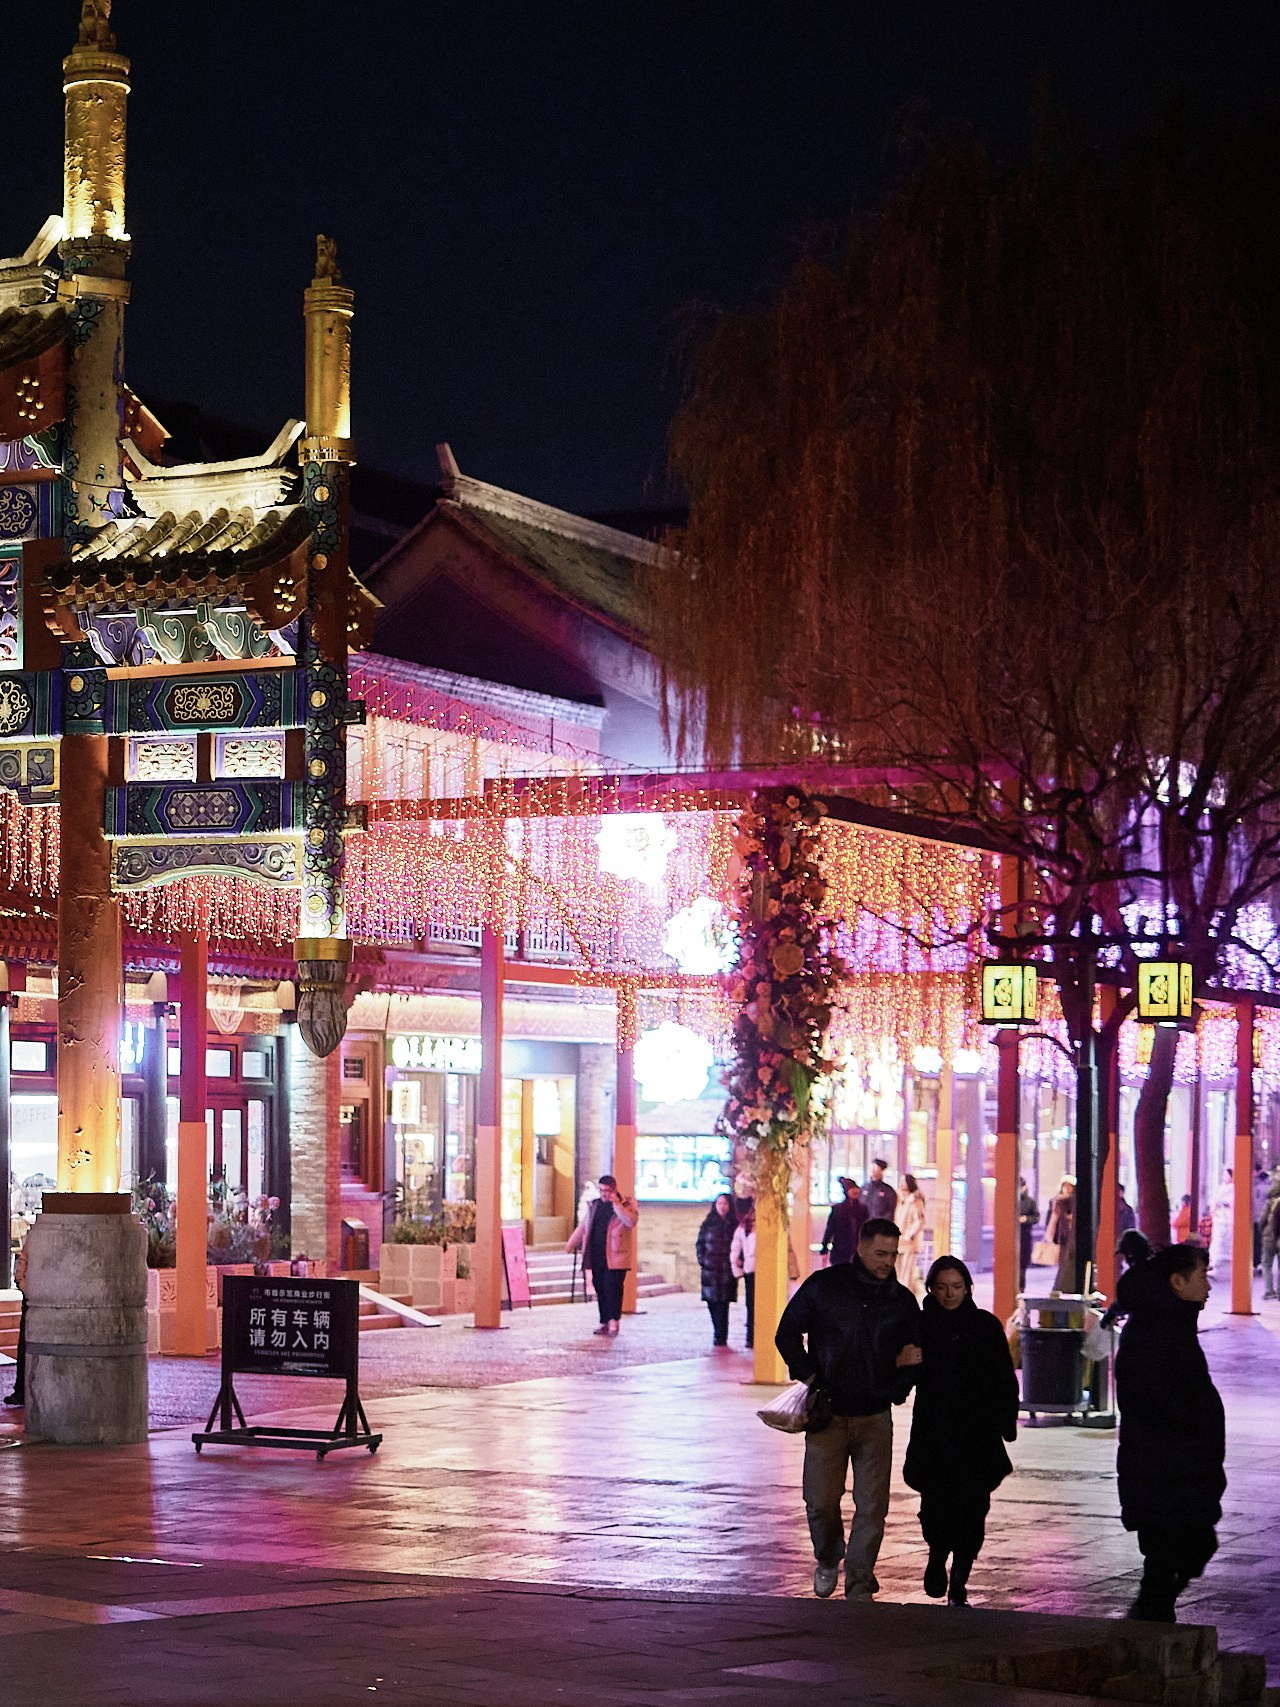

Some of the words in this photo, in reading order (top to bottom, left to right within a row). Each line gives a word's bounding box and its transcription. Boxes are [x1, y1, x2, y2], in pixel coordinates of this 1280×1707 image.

[249, 1307, 331, 1329] 所有车辆
[249, 1327, 330, 1350] 请勿入内
